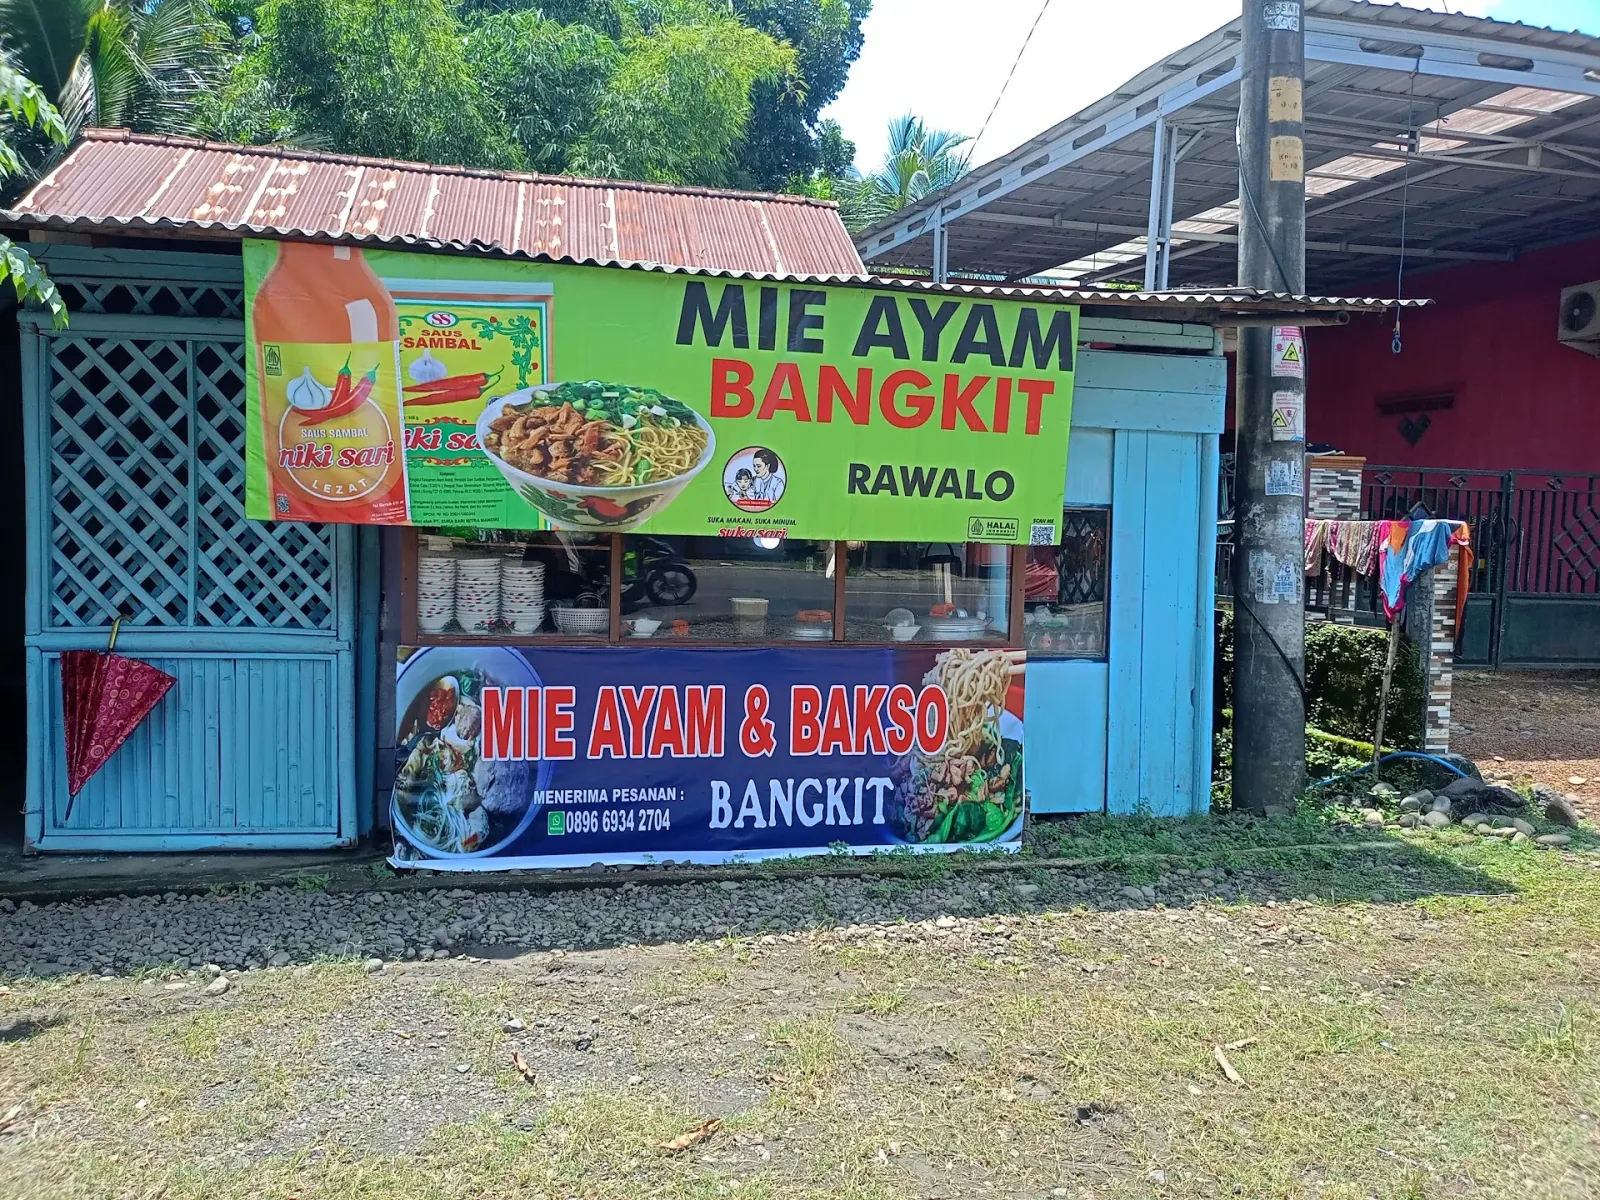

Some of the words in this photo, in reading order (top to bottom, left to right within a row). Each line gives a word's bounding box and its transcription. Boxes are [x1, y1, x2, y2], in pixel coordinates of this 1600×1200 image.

[431, 313, 451, 326] SS
[675, 280, 827, 354] MIE
[851, 295, 1074, 372] AYAM
[421, 329, 462, 337] SAUS
[403, 337, 482, 350] SAMBAL
[709, 358, 1055, 436] BANGKIT
[301, 428, 327, 438] SAUS
[328, 428, 369, 438] SAMBAL
[279, 442, 334, 468] niki
[336, 440, 395, 468] sari
[311, 478, 368, 494] LEZAT
[848, 463, 1015, 502] RAWALO
[707, 516, 724, 524] SUKA
[986, 521, 1016, 530] HALAL
[480, 685, 576, 761] MIE
[587, 684, 726, 759] AYAM
[738, 683, 778, 758] &
[789, 683, 949, 757] BAKSO
[533, 789, 608, 805] MENERIMA
[709, 776, 895, 828] BANGKIT
[566, 810, 598, 833] 0896
[602, 809, 635, 832] 6934
[638, 808, 671, 831] 2704
